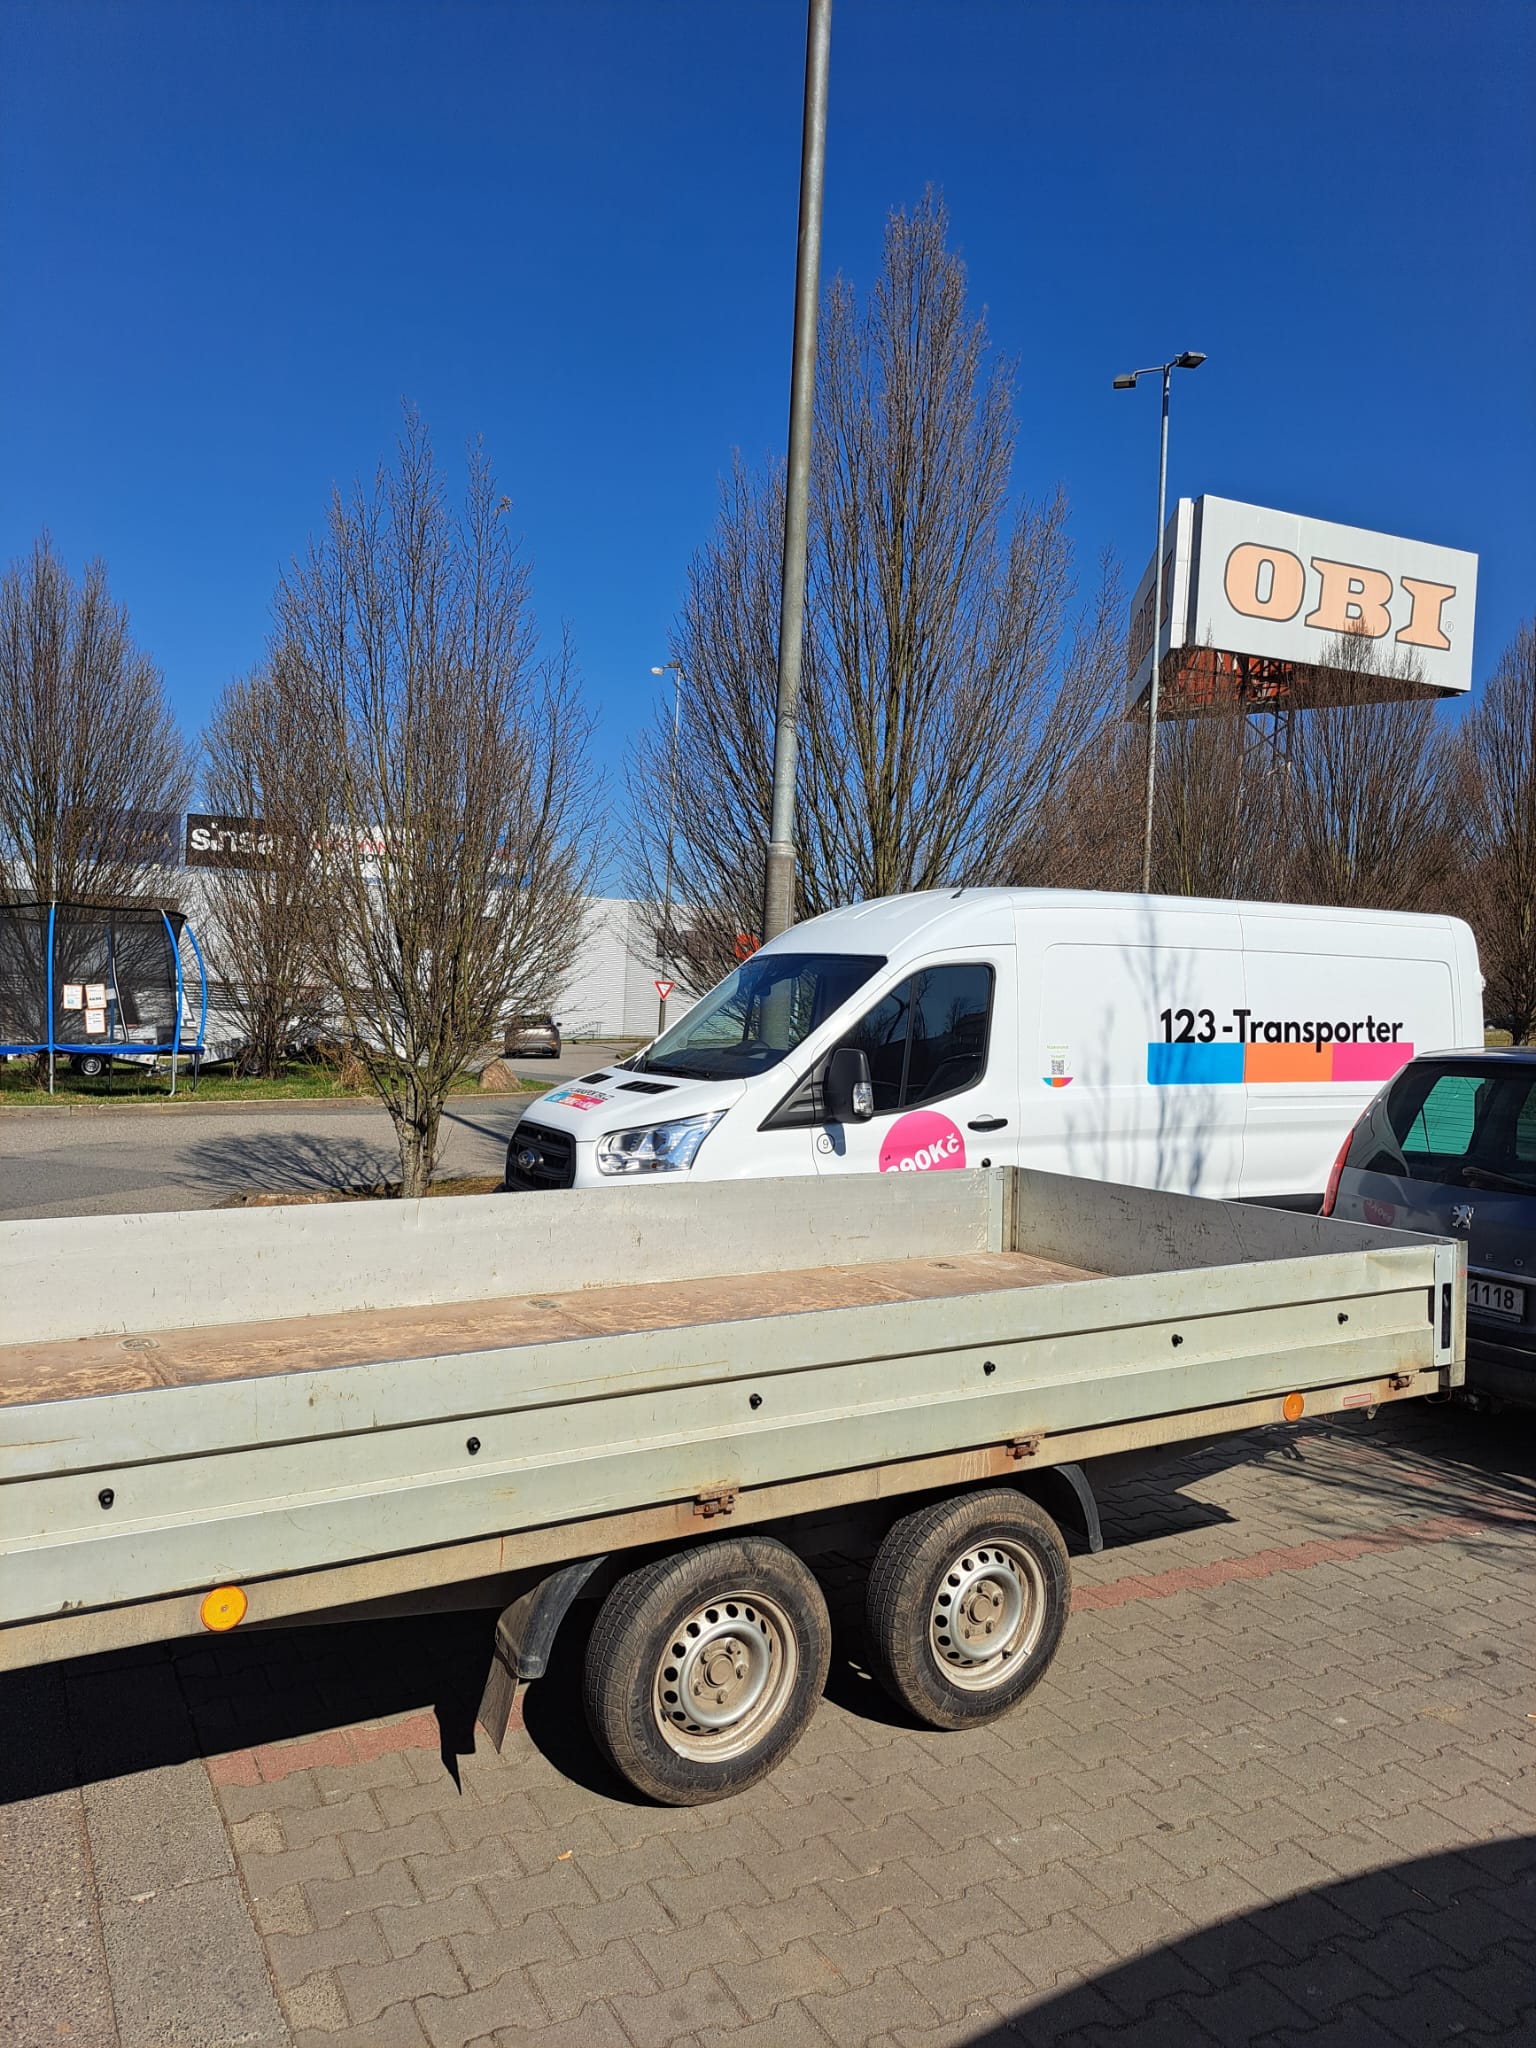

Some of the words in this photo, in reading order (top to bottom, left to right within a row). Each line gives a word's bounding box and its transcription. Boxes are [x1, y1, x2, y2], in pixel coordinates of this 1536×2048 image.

[1224, 542, 1456, 651] OBI
[1160, 1008, 1403, 1053] 123-Transporter
[1471, 1282, 1514, 1310] 1118
